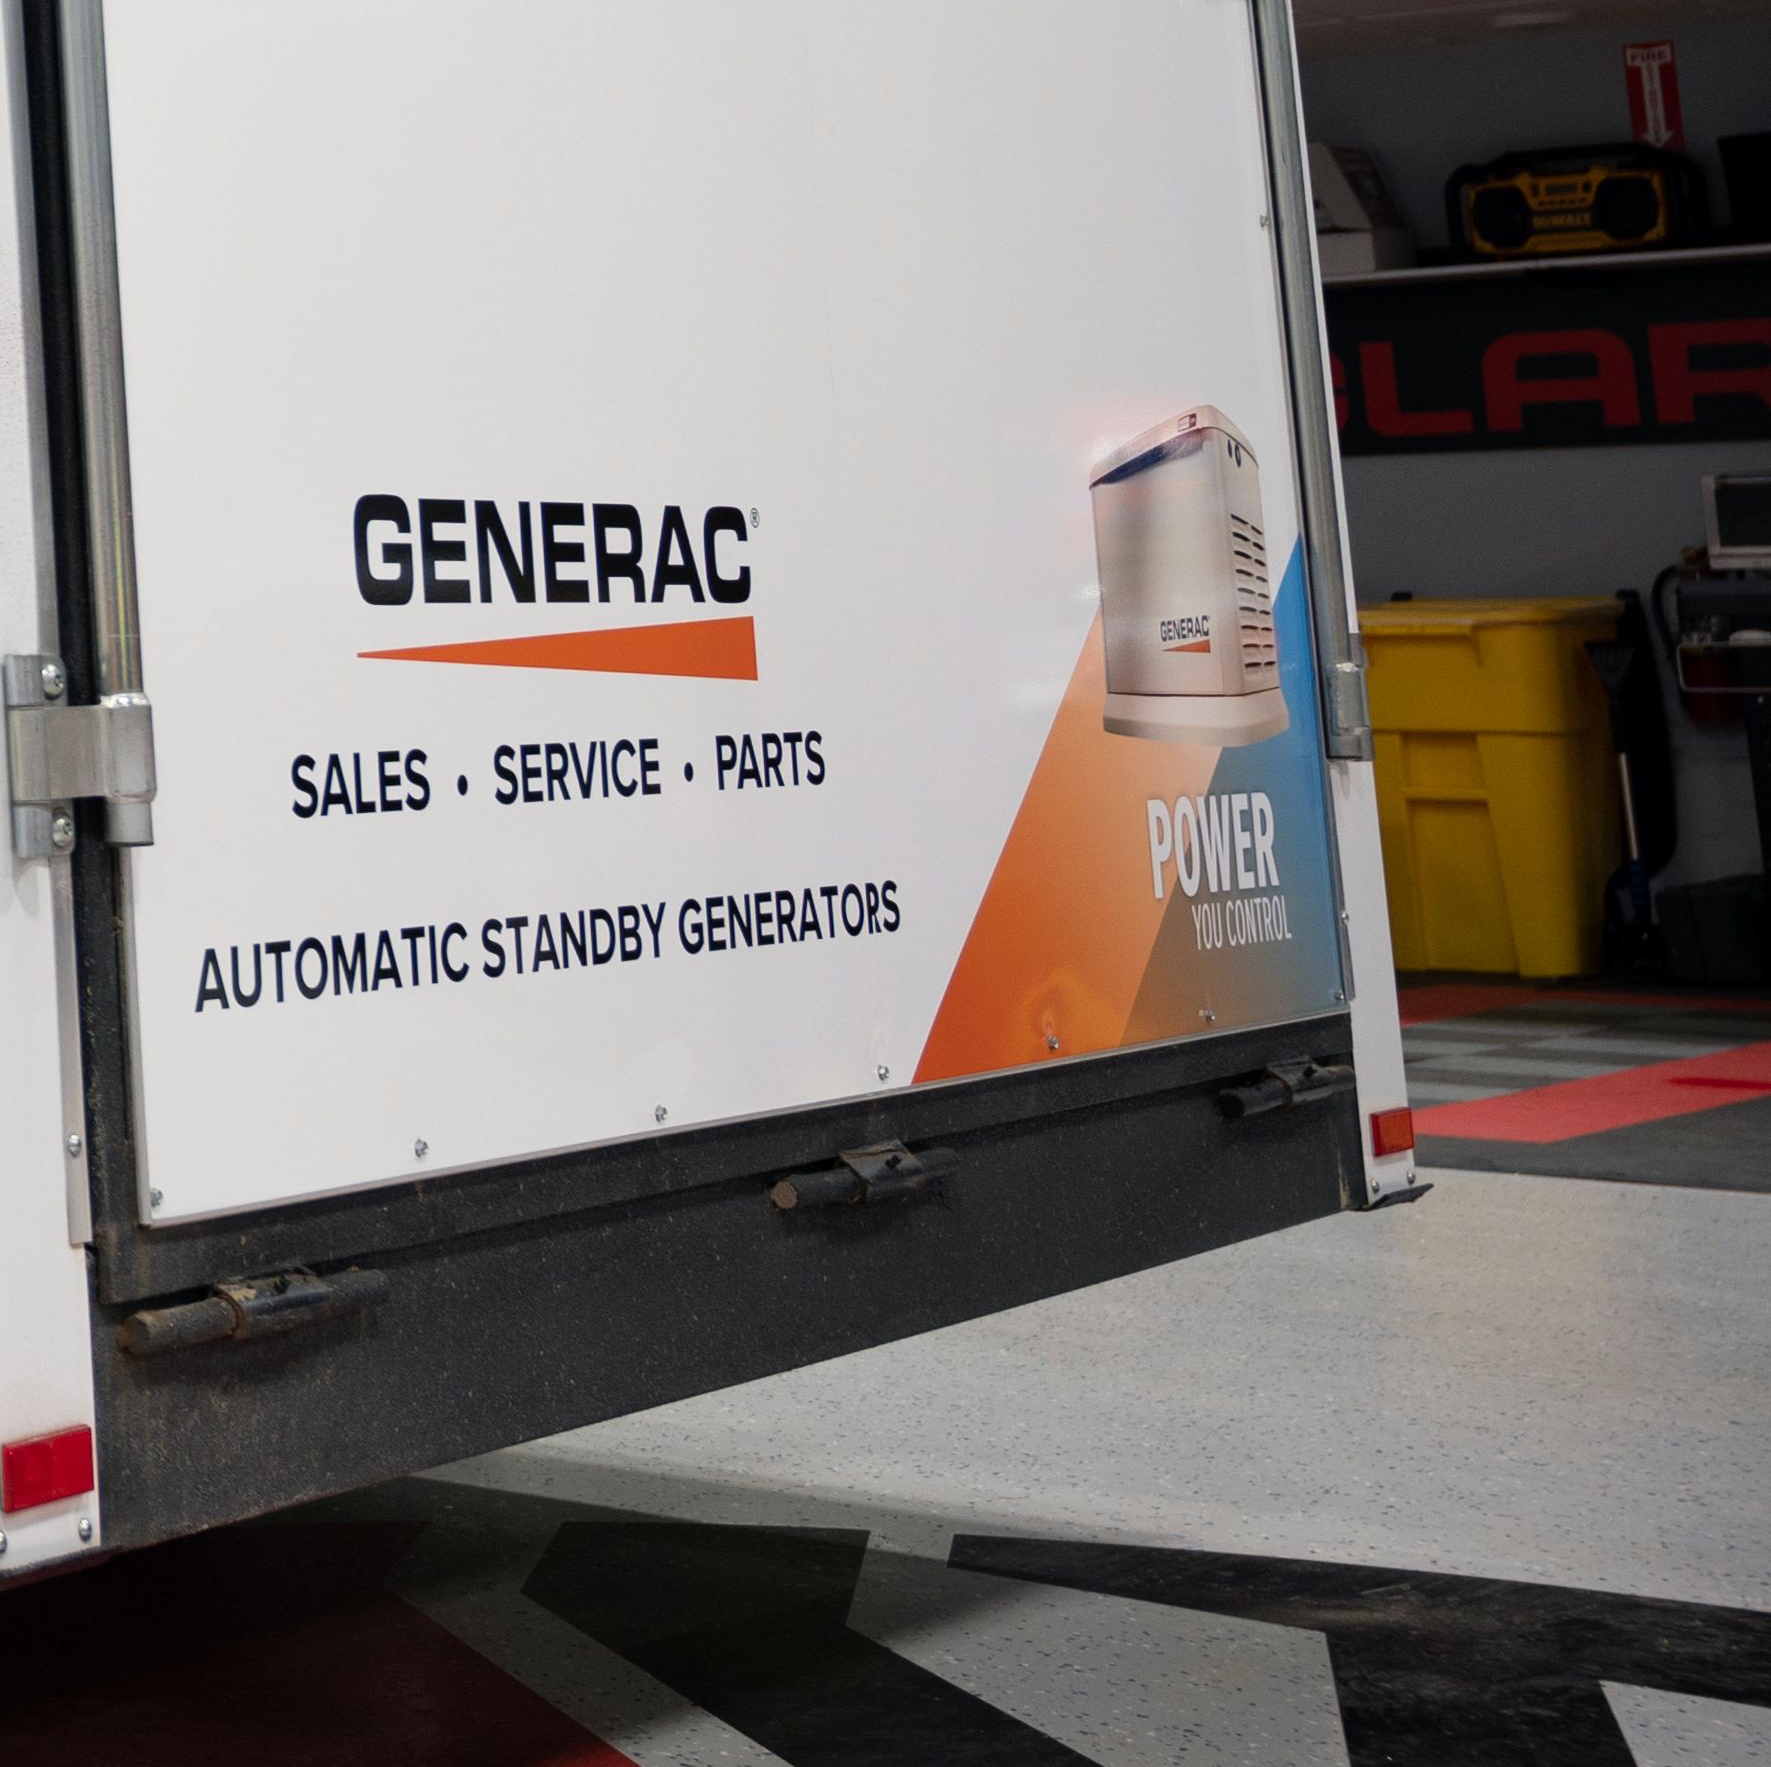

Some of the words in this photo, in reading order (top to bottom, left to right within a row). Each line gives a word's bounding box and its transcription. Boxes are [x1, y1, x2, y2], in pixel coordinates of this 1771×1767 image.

[1330, 318, 1771, 438] LAR
[290, 748, 432, 819] SALES
[492, 738, 662, 806] SERVICE
[714, 730, 826, 791] PARTS
[1146, 791, 1280, 900] POWER
[194, 922, 470, 1013] AUTOMATIC
[481, 901, 667, 978] STANDBY
[677, 879, 902, 956] GENERATORS
[1190, 903, 1223, 951] YOU
[1225, 895, 1292, 945] CONTROL
